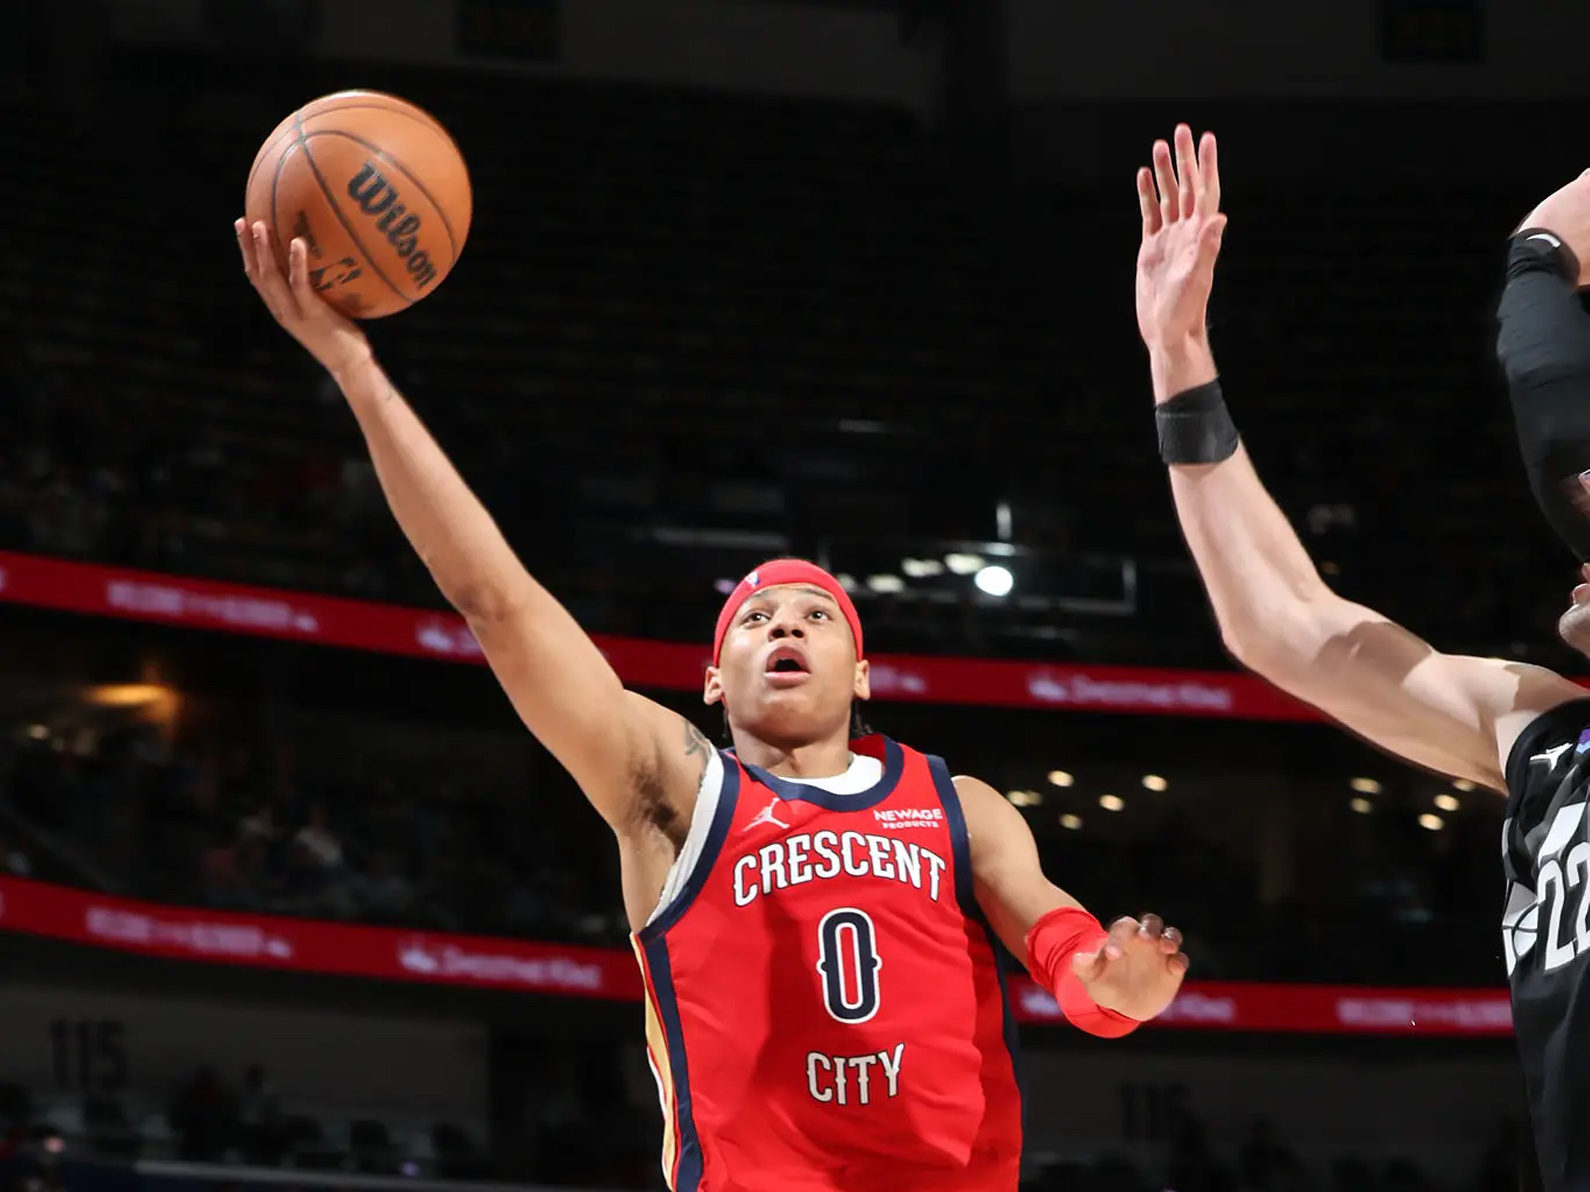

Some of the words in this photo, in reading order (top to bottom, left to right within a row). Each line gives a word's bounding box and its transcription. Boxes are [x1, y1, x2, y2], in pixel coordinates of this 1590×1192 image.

[347, 160, 438, 291] Wilson
[873, 808, 943, 821] NEWAGE
[882, 820, 939, 829] PRODUCTS
[733, 831, 946, 907] CRESCENT
[1537, 842, 1590, 974] 22
[817, 907, 882, 1024] 0
[806, 1043, 904, 1105] CITY
